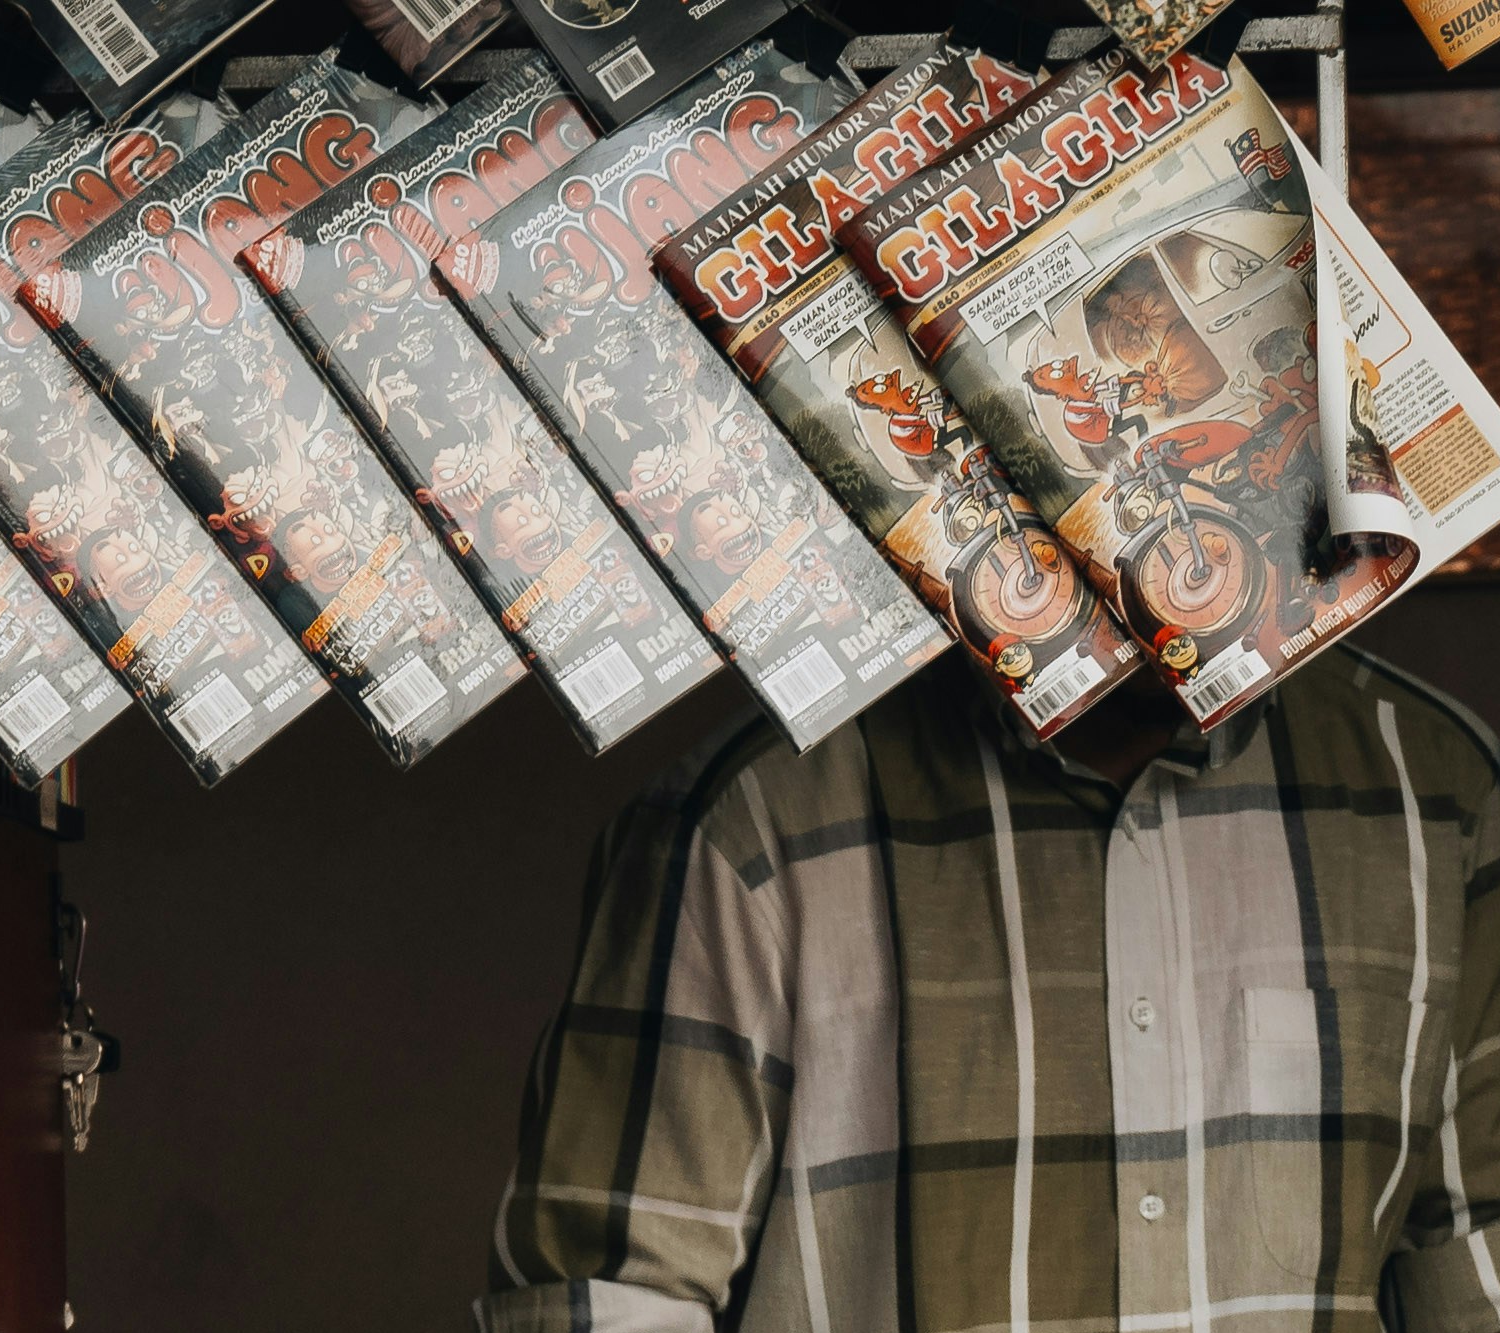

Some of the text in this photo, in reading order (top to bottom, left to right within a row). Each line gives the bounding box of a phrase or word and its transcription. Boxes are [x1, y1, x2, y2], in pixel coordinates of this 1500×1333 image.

[94, 89, 328, 275] Majalah Lawak Antarabangsa
[317, 141, 453, 243] Majalah Lawak
[511, 71, 755, 250] Majalah Lawak Antarabangsa
[681, 46, 970, 261] MAJALAH HUMOR NASIONA
[695, 47, 1036, 324] GILA-GILA
[865, 98, 1057, 239] MAJALAH HUMOR
[877, 51, 1231, 303] GILA-GILA
[789, 281, 855, 336] SAMAN EKOR
[968, 241, 1073, 320] SAMAN EKOR MOTOR
[1043, 258, 1072, 284] TIGA
[1279, 577, 1386, 659] BUDIN NIAGA BUNDLE
